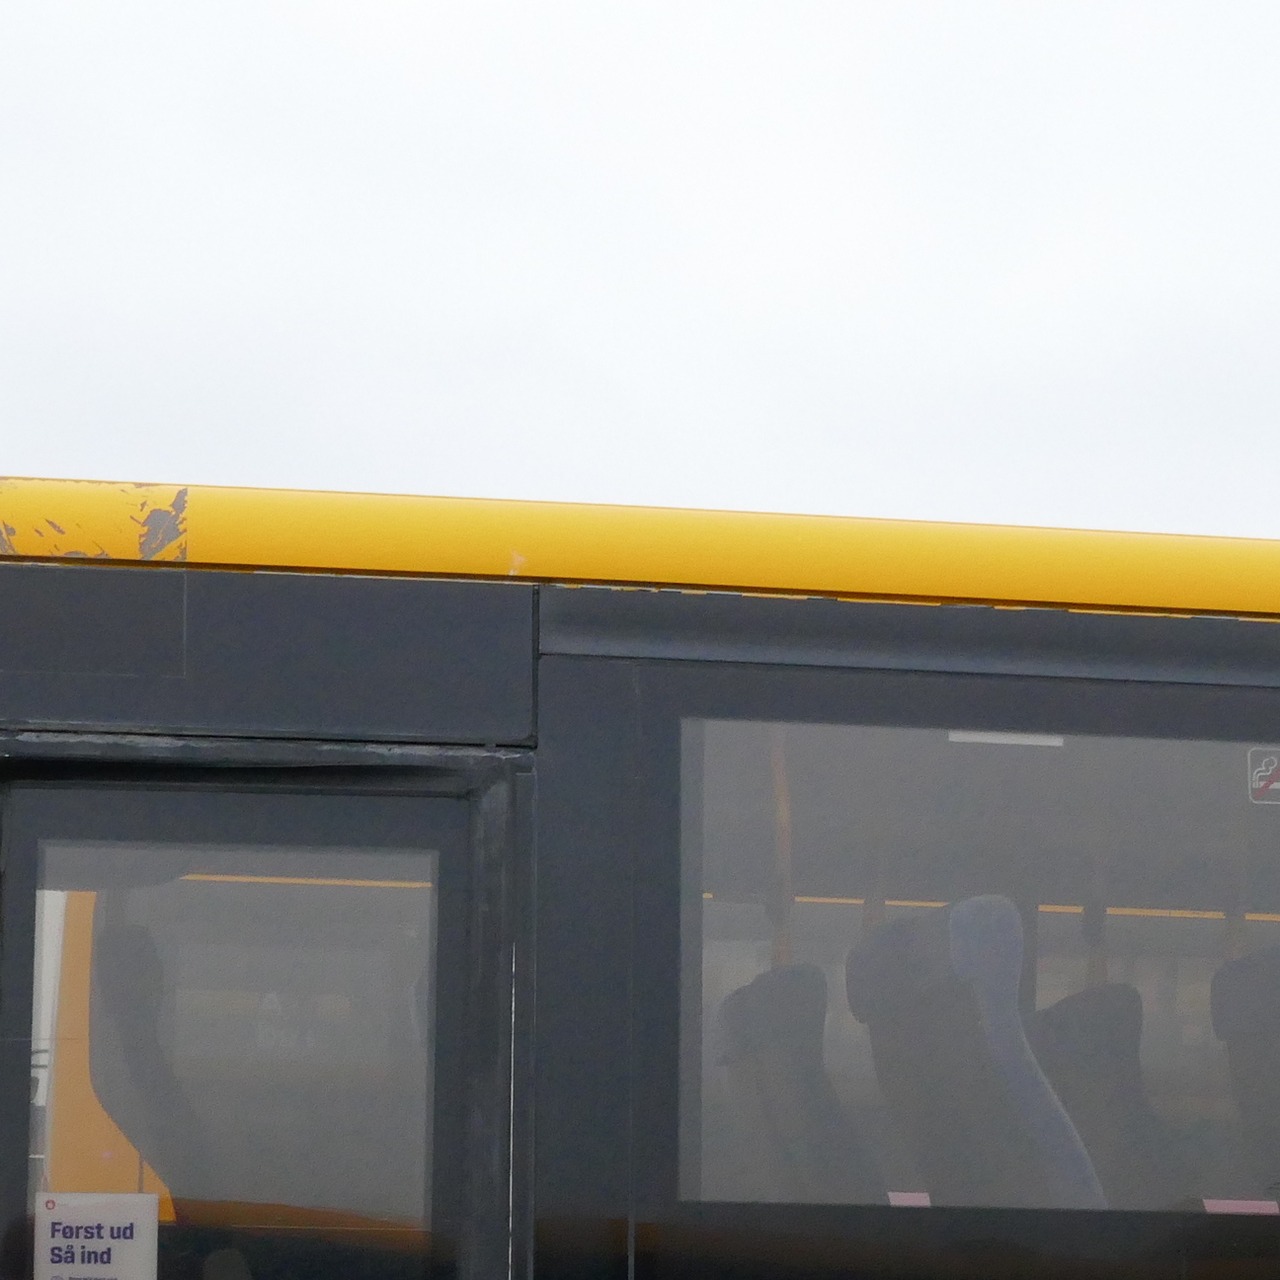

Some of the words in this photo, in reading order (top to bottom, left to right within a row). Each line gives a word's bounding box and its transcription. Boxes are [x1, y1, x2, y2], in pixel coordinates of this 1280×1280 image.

[50, 1221, 105, 1240] Først
[110, 1222, 134, 1240] ud
[50, 1244, 75, 1264] Så
[80, 1245, 111, 1264] ind
